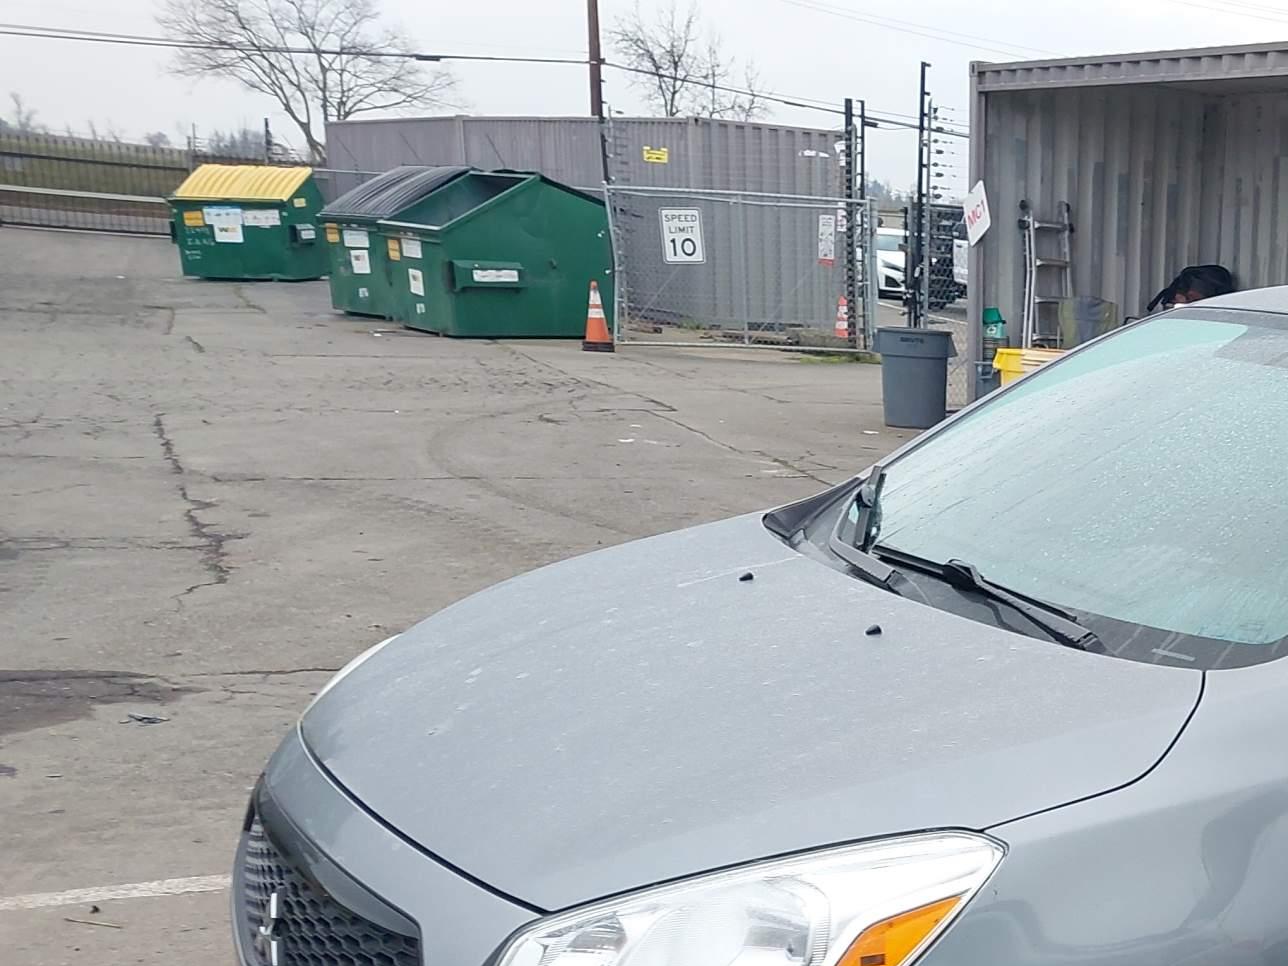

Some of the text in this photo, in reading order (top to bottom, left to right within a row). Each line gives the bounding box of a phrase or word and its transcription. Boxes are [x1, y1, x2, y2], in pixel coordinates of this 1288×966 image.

[664, 214, 697, 222] SPEED
[668, 226, 695, 234] LIMIT
[670, 237, 697, 257] 10
